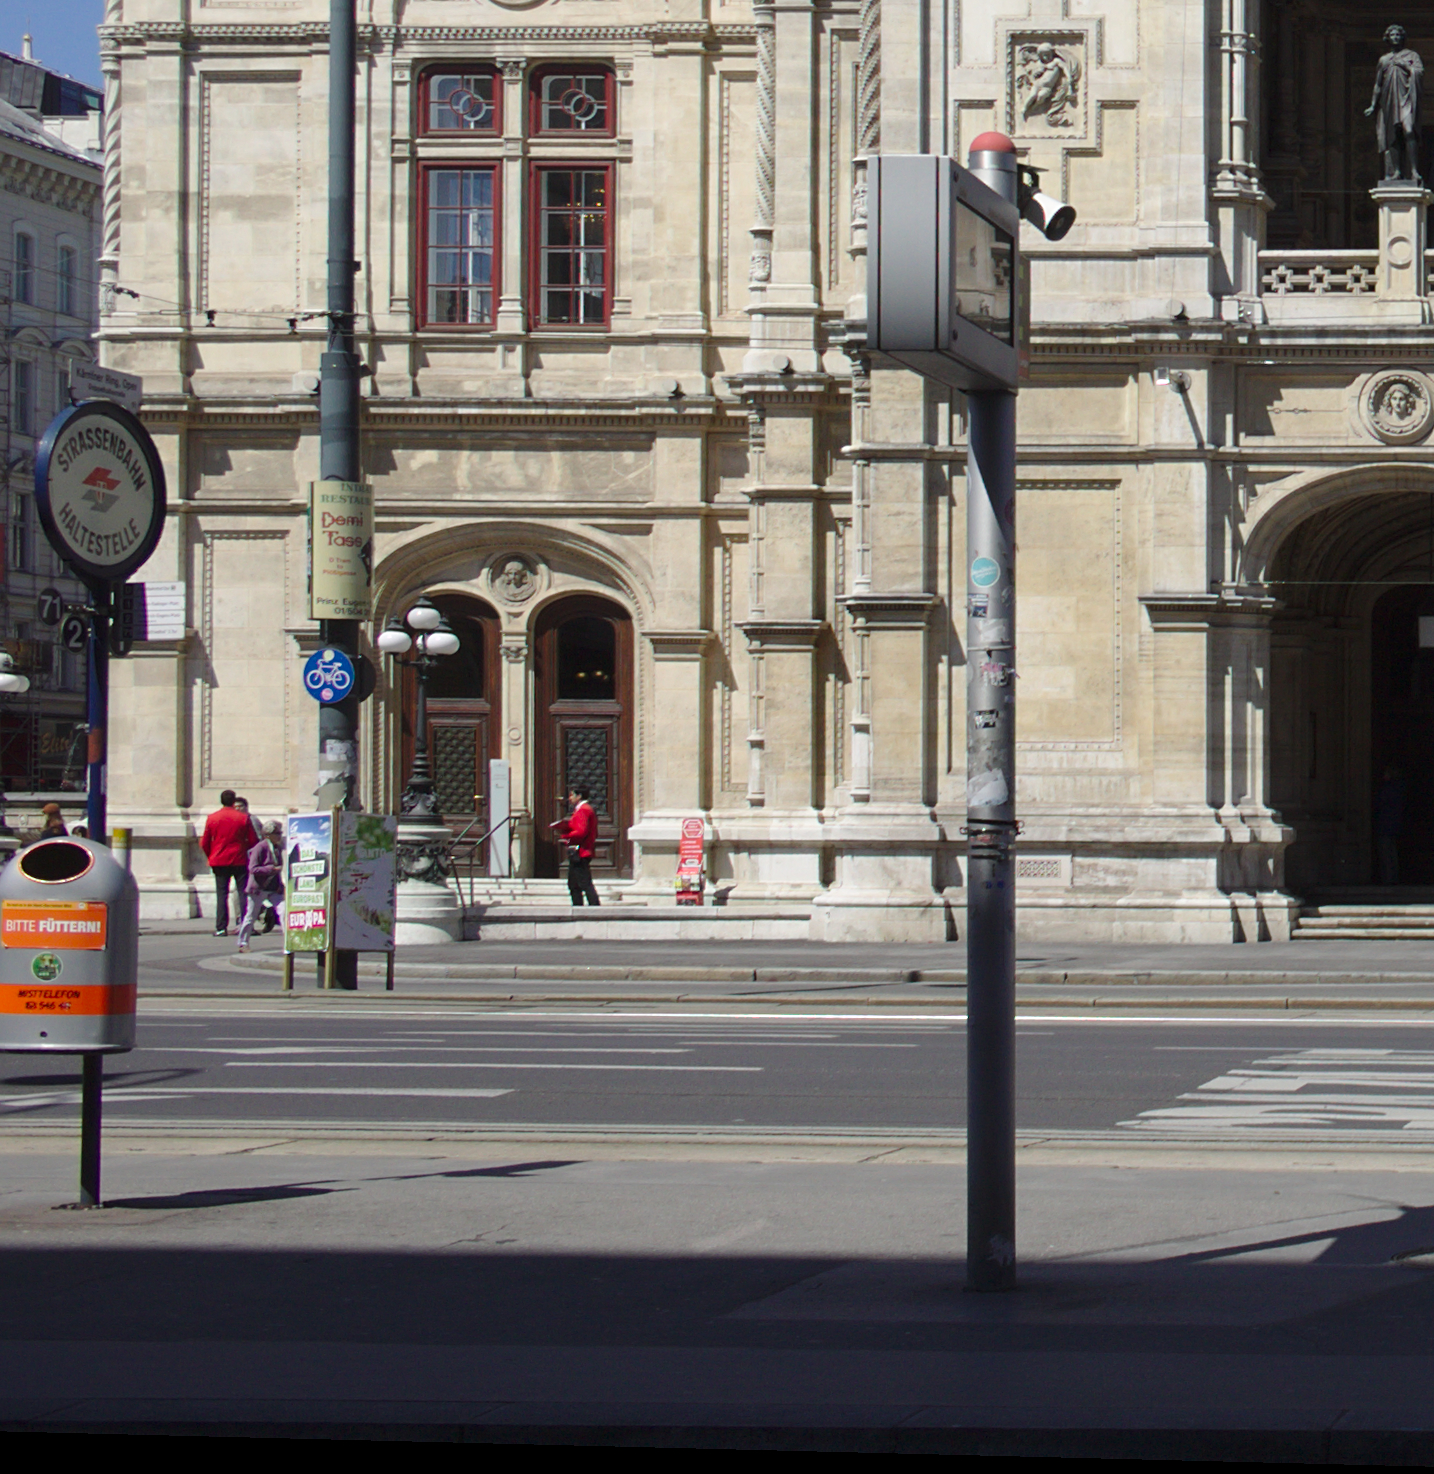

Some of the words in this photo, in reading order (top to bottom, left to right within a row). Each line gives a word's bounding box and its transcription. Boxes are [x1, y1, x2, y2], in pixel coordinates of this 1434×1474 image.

[57, 426, 147, 493] STRASSENBAHN
[58, 501, 141, 558] HALTESTELLE
[321, 511, 364, 529] Demi
[322, 530, 363, 548] Tass
[40, 594, 62, 620] 71
[67, 621, 83, 649] 2
[6, 919, 36, 933] BITTE
[39, 917, 102, 934] FÜTTERN!
[17, 989, 81, 999] MISTTELEFON
